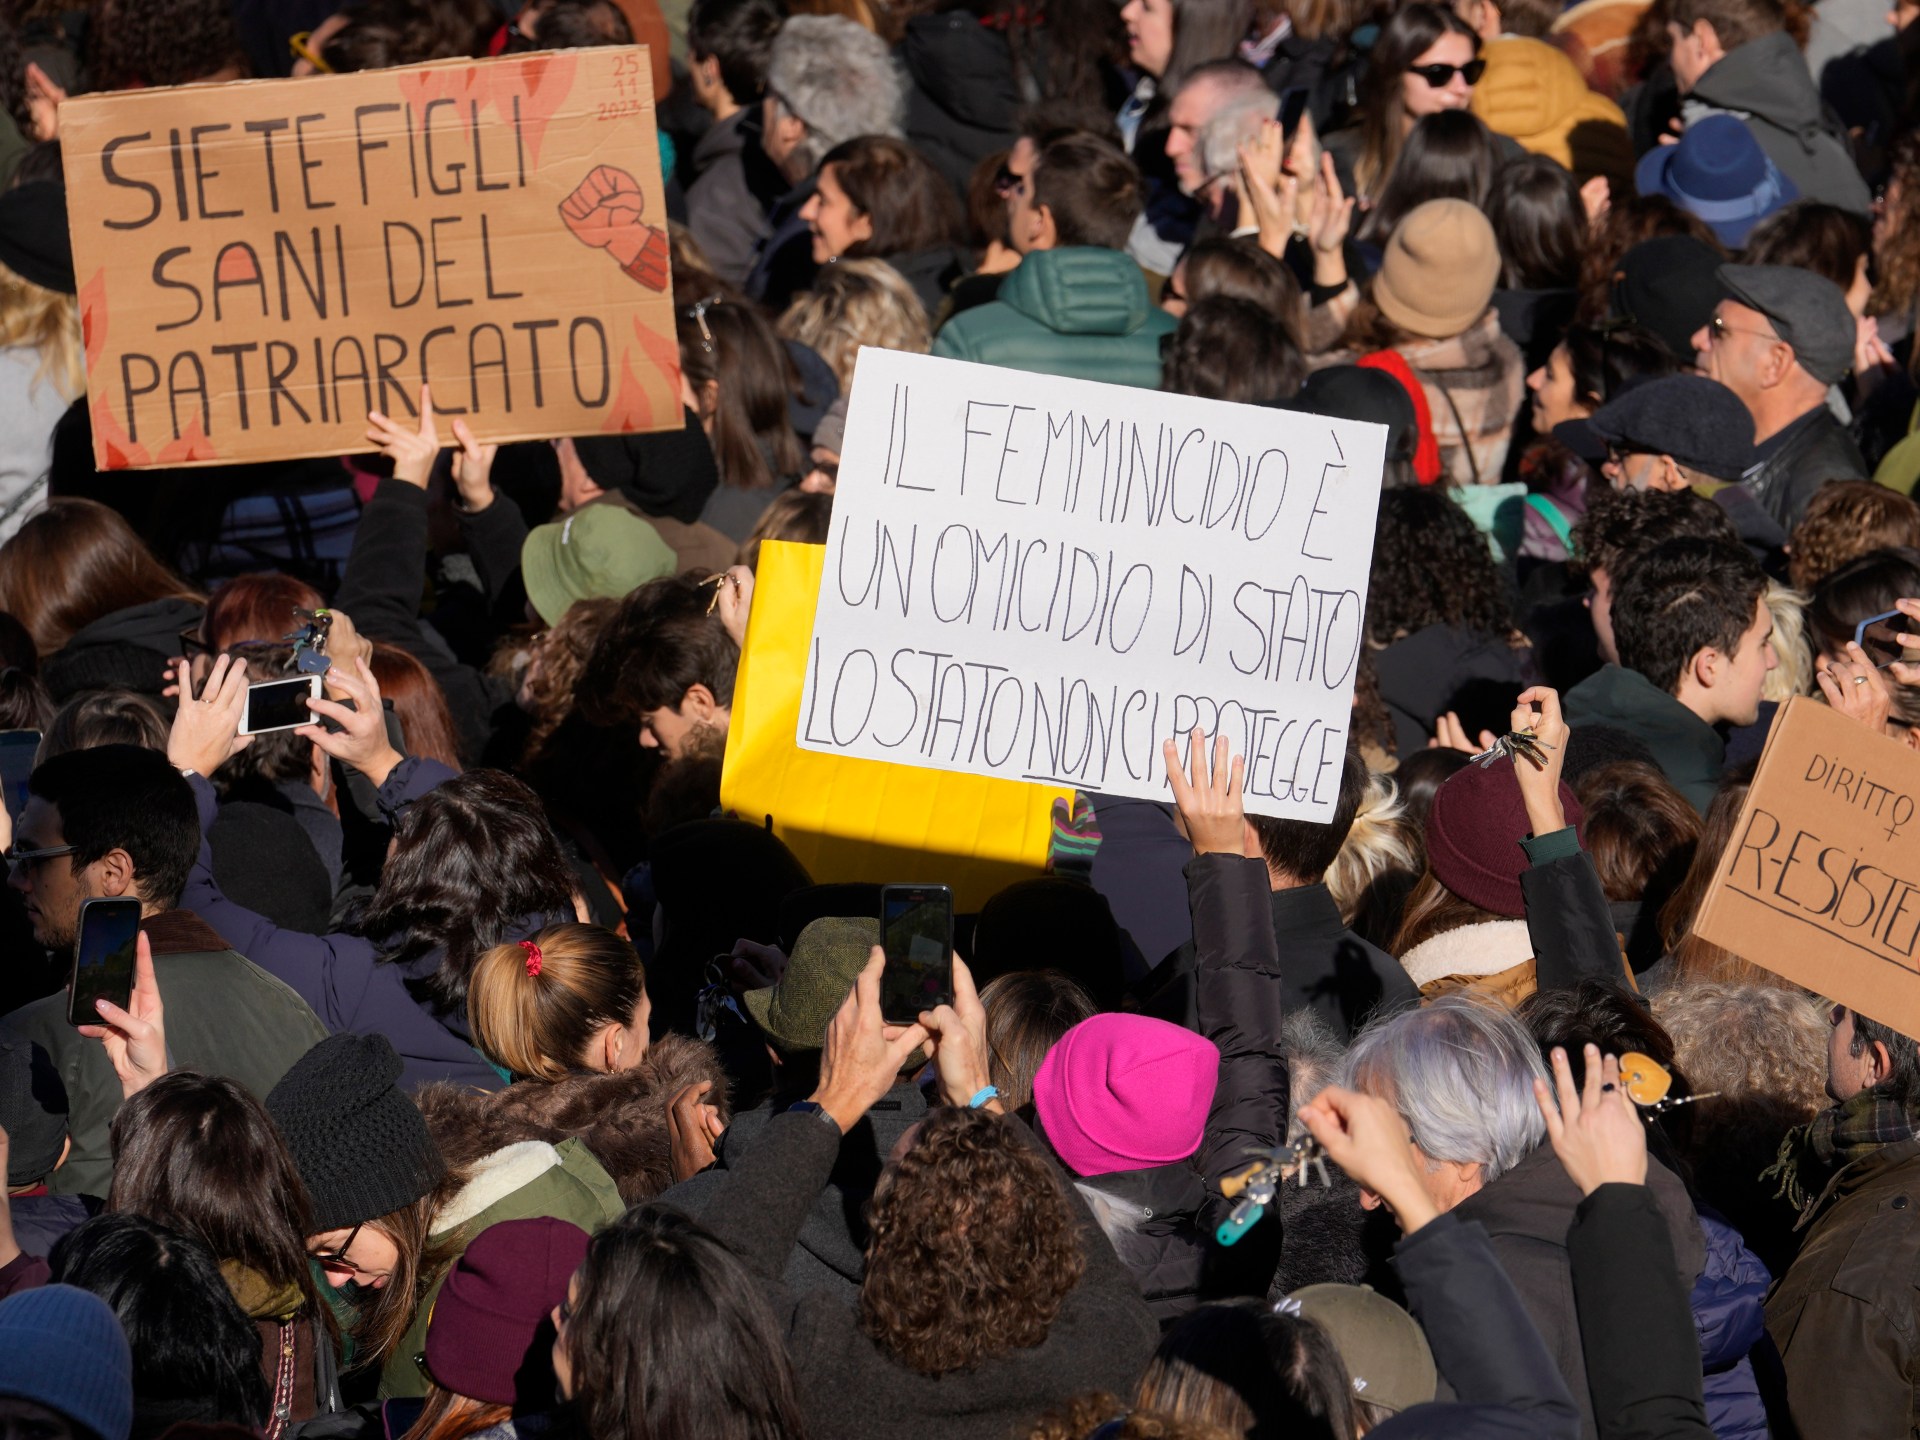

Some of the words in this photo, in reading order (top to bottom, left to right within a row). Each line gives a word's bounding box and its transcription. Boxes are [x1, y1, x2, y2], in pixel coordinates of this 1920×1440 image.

[596, 99, 641, 122] 2023
[611, 53, 640, 77] 25
[612, 78, 638, 97] 11
[101, 112, 336, 231] SIETE
[353, 95, 527, 206] FIGLI
[151, 223, 349, 332] SANI
[382, 213, 524, 310] DEL
[119, 314, 611, 444] PATRIARCATO
[882, 382, 936, 492] IL
[960, 399, 1290, 542] FEMMINICIDIO
[1300, 428, 1347, 561] È
[838, 514, 918, 618] UN
[930, 523, 1154, 654] OMICIDIO
[1173, 563, 1213, 665] DI
[1228, 574, 1361, 690] STATO
[803, 636, 879, 747] LO
[871, 648, 1024, 768] STATO
[1027, 675, 1118, 781] NON
[1120, 688, 1160, 783] CI
